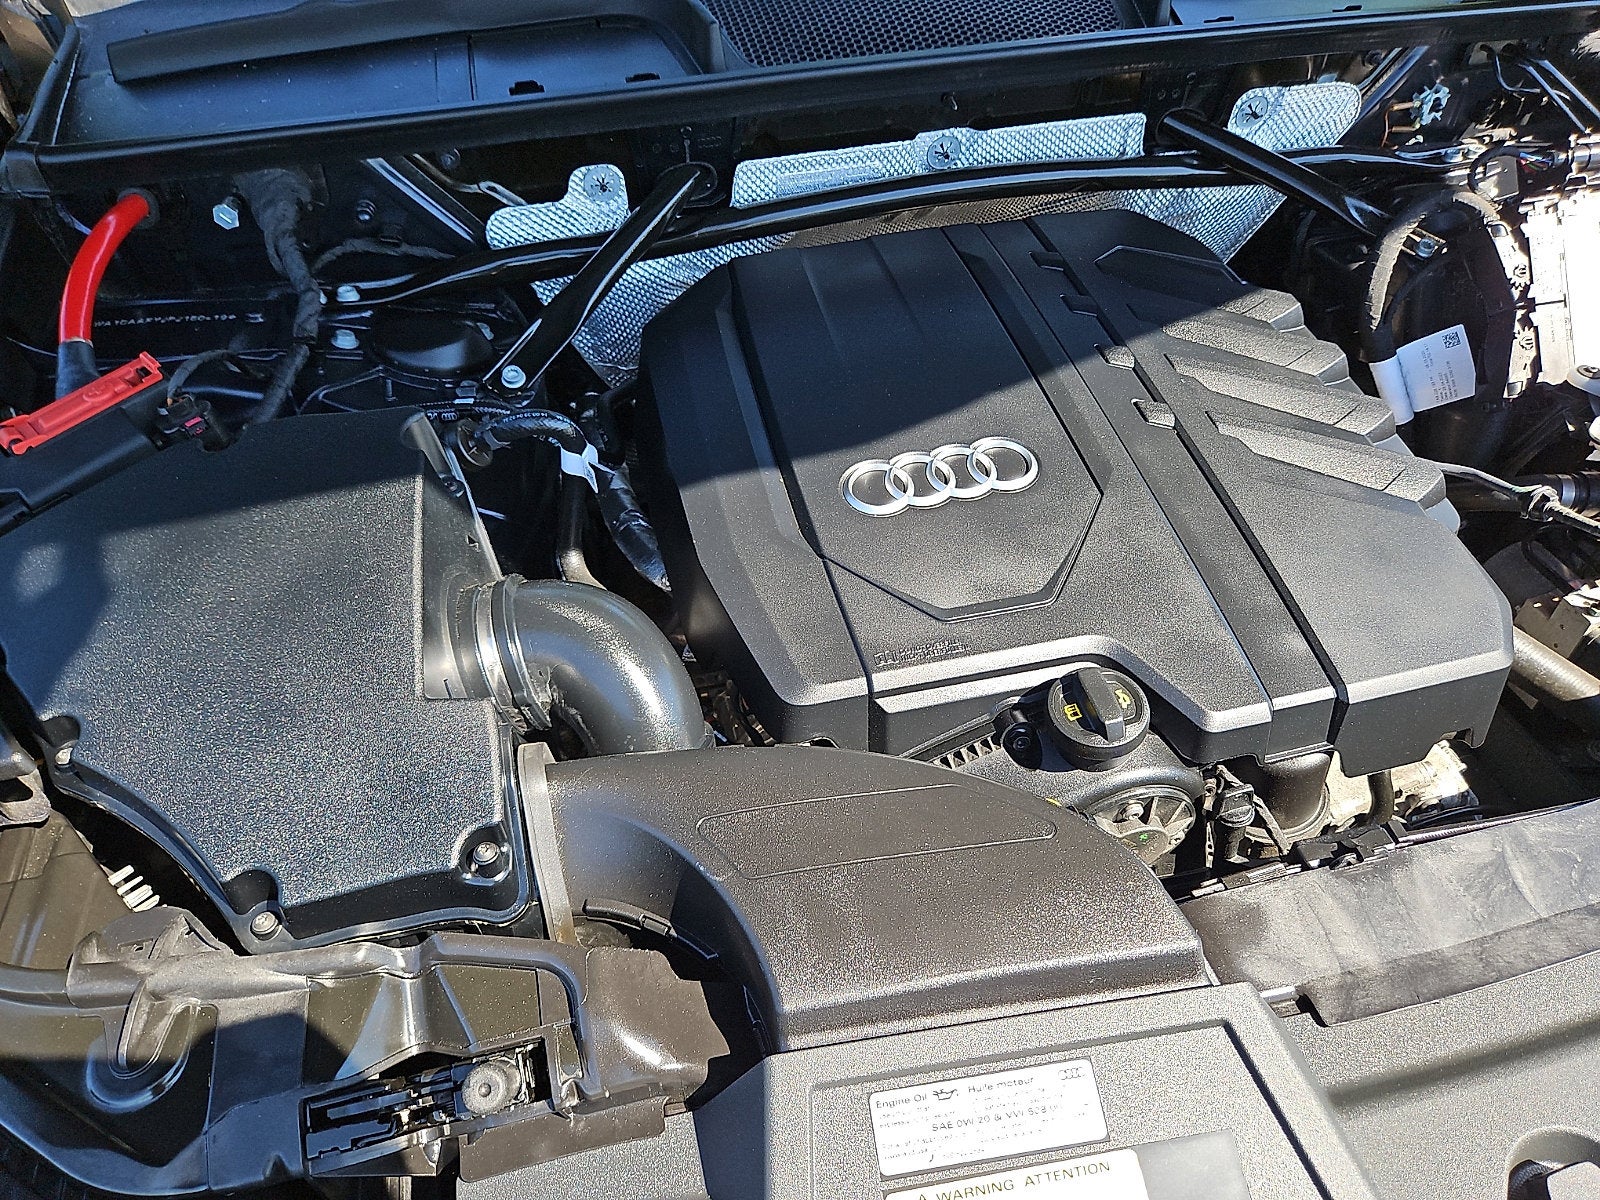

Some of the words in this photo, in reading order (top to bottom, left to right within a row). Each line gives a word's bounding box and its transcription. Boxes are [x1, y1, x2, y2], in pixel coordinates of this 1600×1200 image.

[875, 1098, 911, 1110] Engine
[913, 1093, 927, 1103] Oil
[931, 1120, 954, 1132] SAE
[935, 1179, 1014, 1200] WARNING
[1024, 1161, 1111, 1188] ATTENTION
